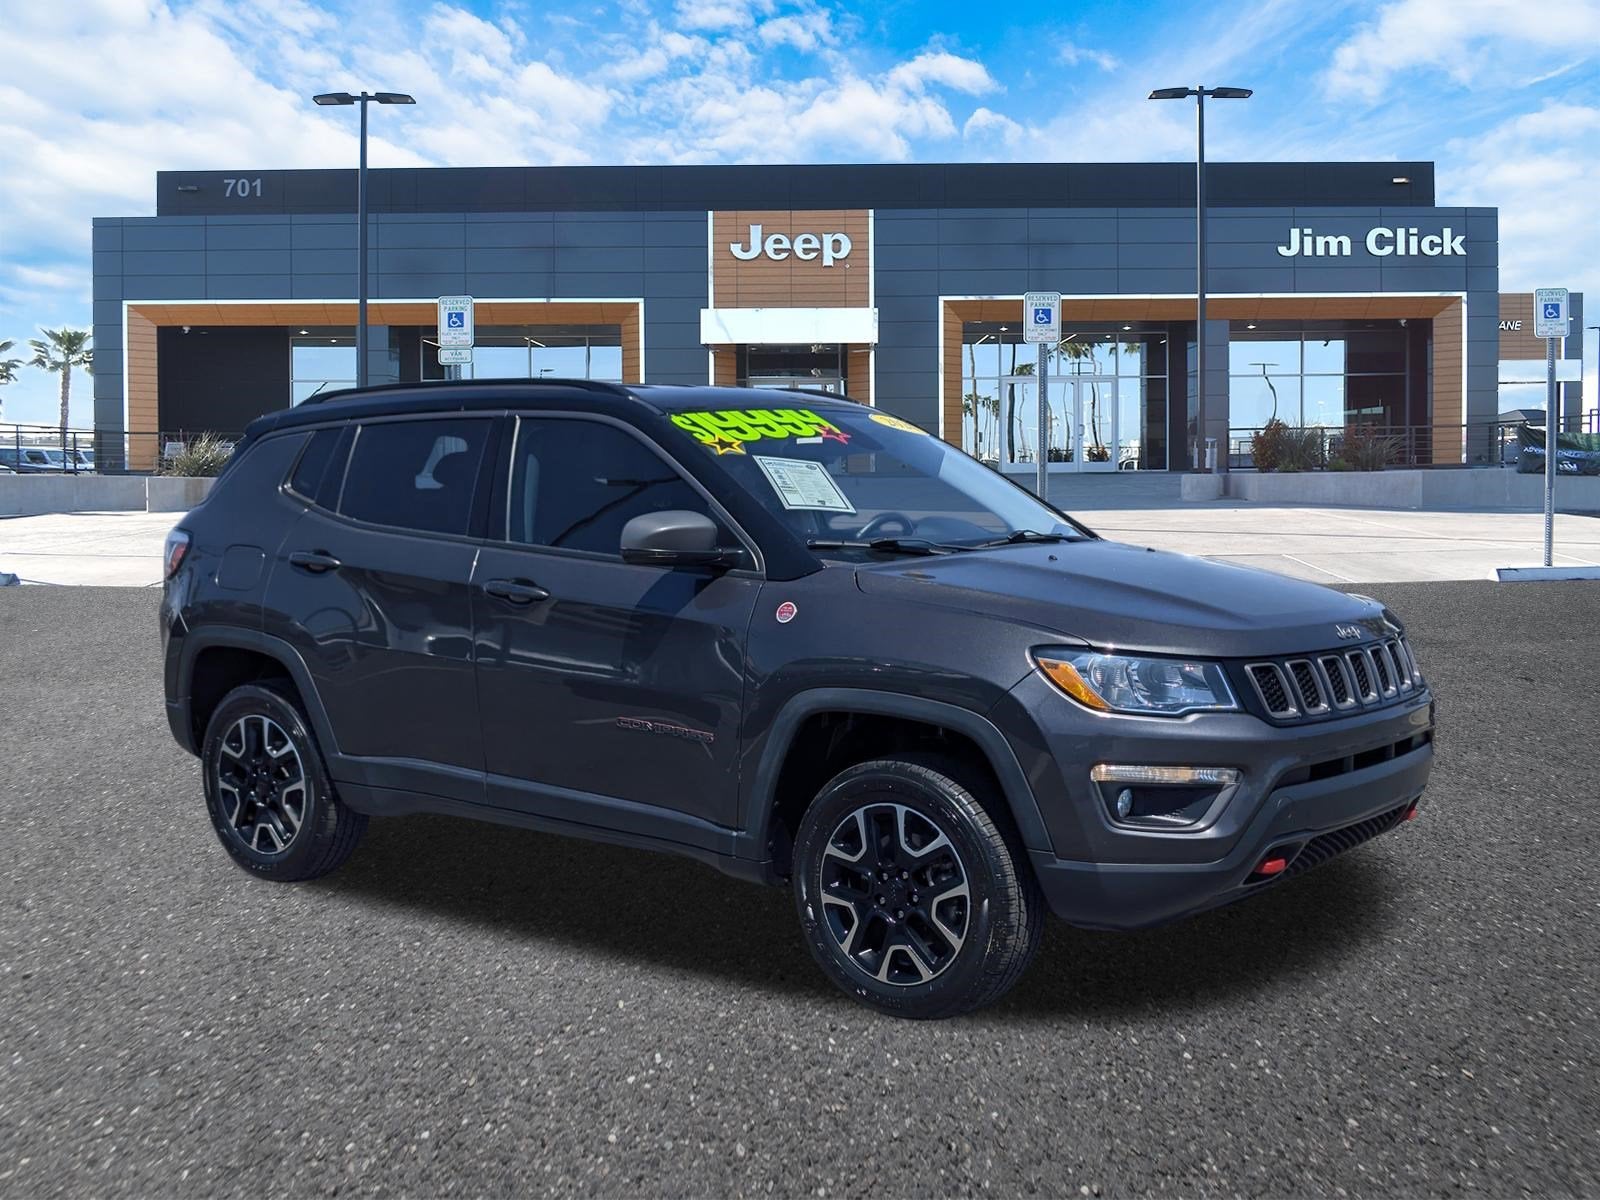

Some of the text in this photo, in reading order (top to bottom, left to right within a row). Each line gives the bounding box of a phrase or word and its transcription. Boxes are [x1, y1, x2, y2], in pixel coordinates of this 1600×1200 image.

[223, 178, 262, 198] 701
[729, 223, 852, 268] Jeep
[1276, 226, 1468, 257] Jim Click
